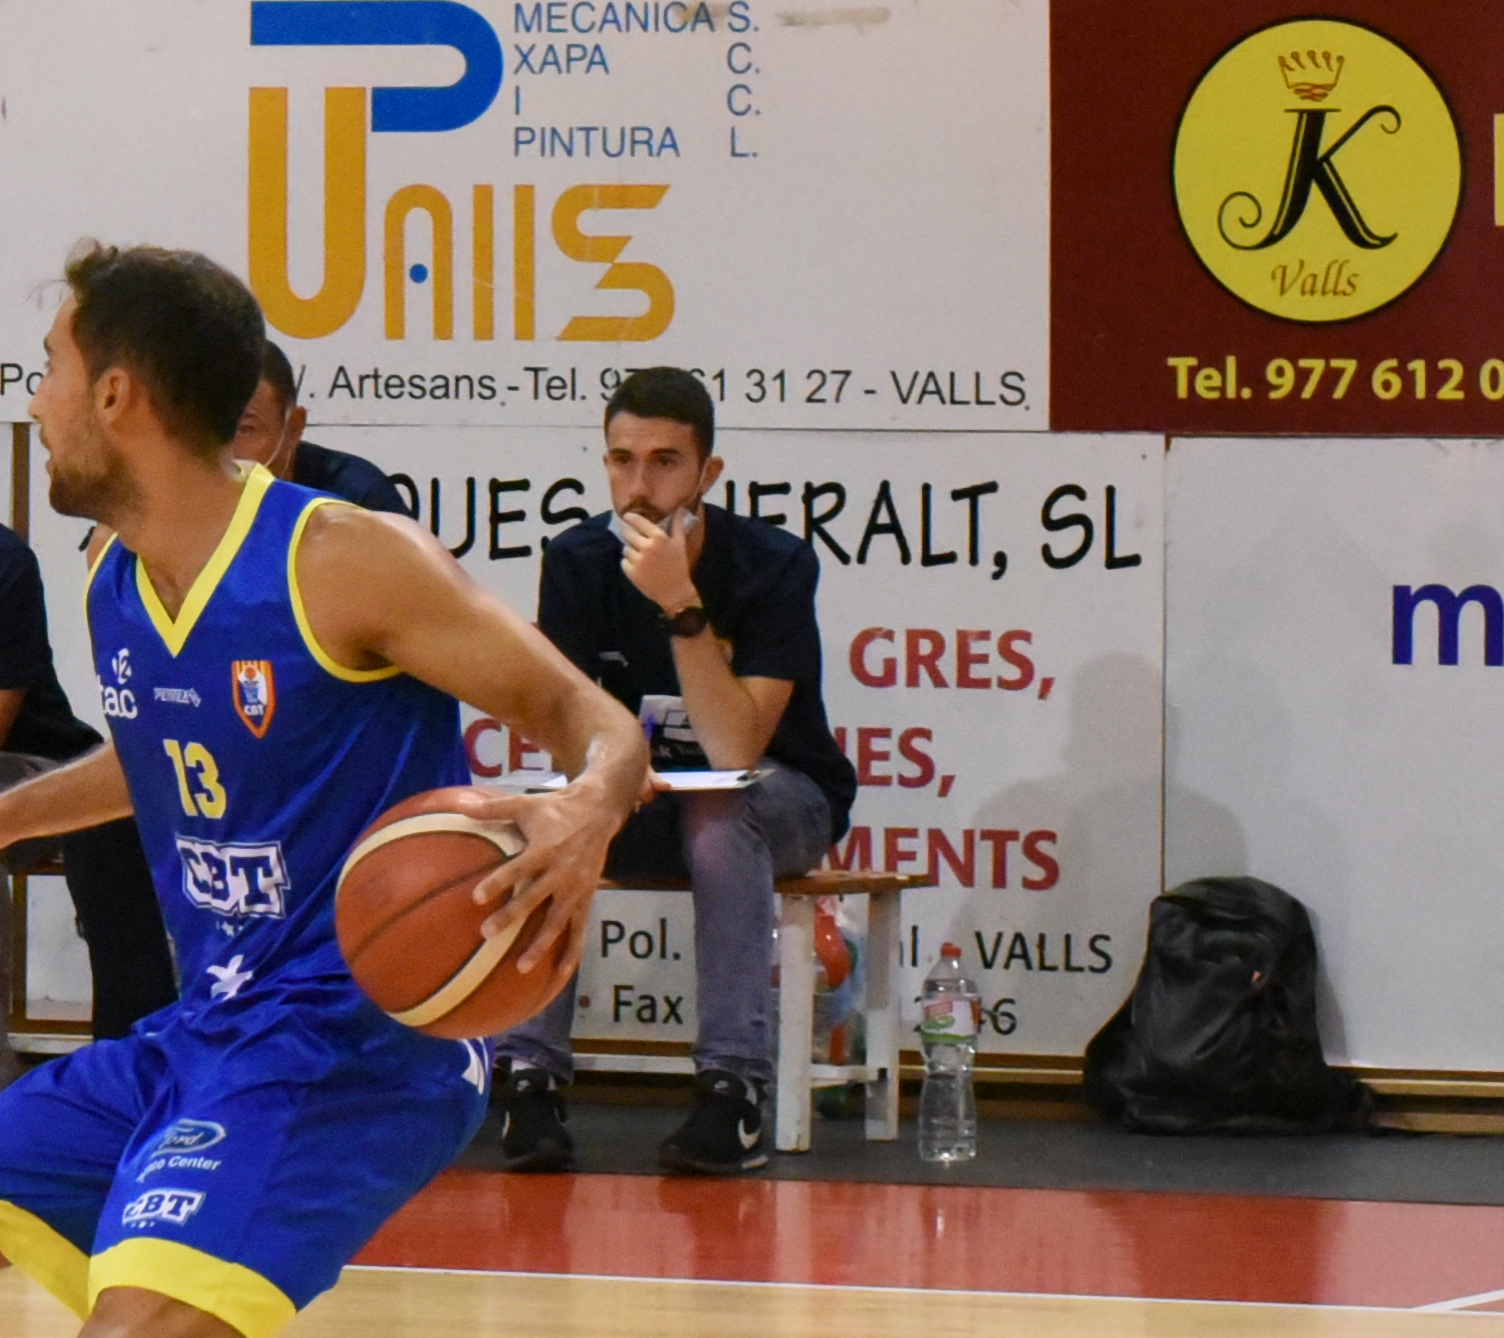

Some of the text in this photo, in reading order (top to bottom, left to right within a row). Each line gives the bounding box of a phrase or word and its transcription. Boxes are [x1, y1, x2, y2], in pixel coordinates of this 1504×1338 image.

[725, 0, 761, 35] S.
[513, 41, 761, 77] XAPA C.
[513, 84, 761, 118] I C.
[513, 125, 759, 159] PINTURA L.
[1270, 259, 1360, 300] Valls
[328, 365, 497, 401] Artesans
[745, 369, 788, 405] 31
[804, 369, 853, 405] 27
[1167, 356, 1253, 401] Tel.
[1265, 358, 1358, 401] 977
[1371, 358, 1465, 401] 612
[1040, 482, 1142, 570] SL
[849, 627, 1057, 700] GRES,
[163, 738, 228, 820] 13
[175, 832, 291, 920] CBT
[600, 919, 1113, 974] Pol. VALLS
[612, 984, 683, 1025] Fax
[167, 1155, 223, 1172] Center
